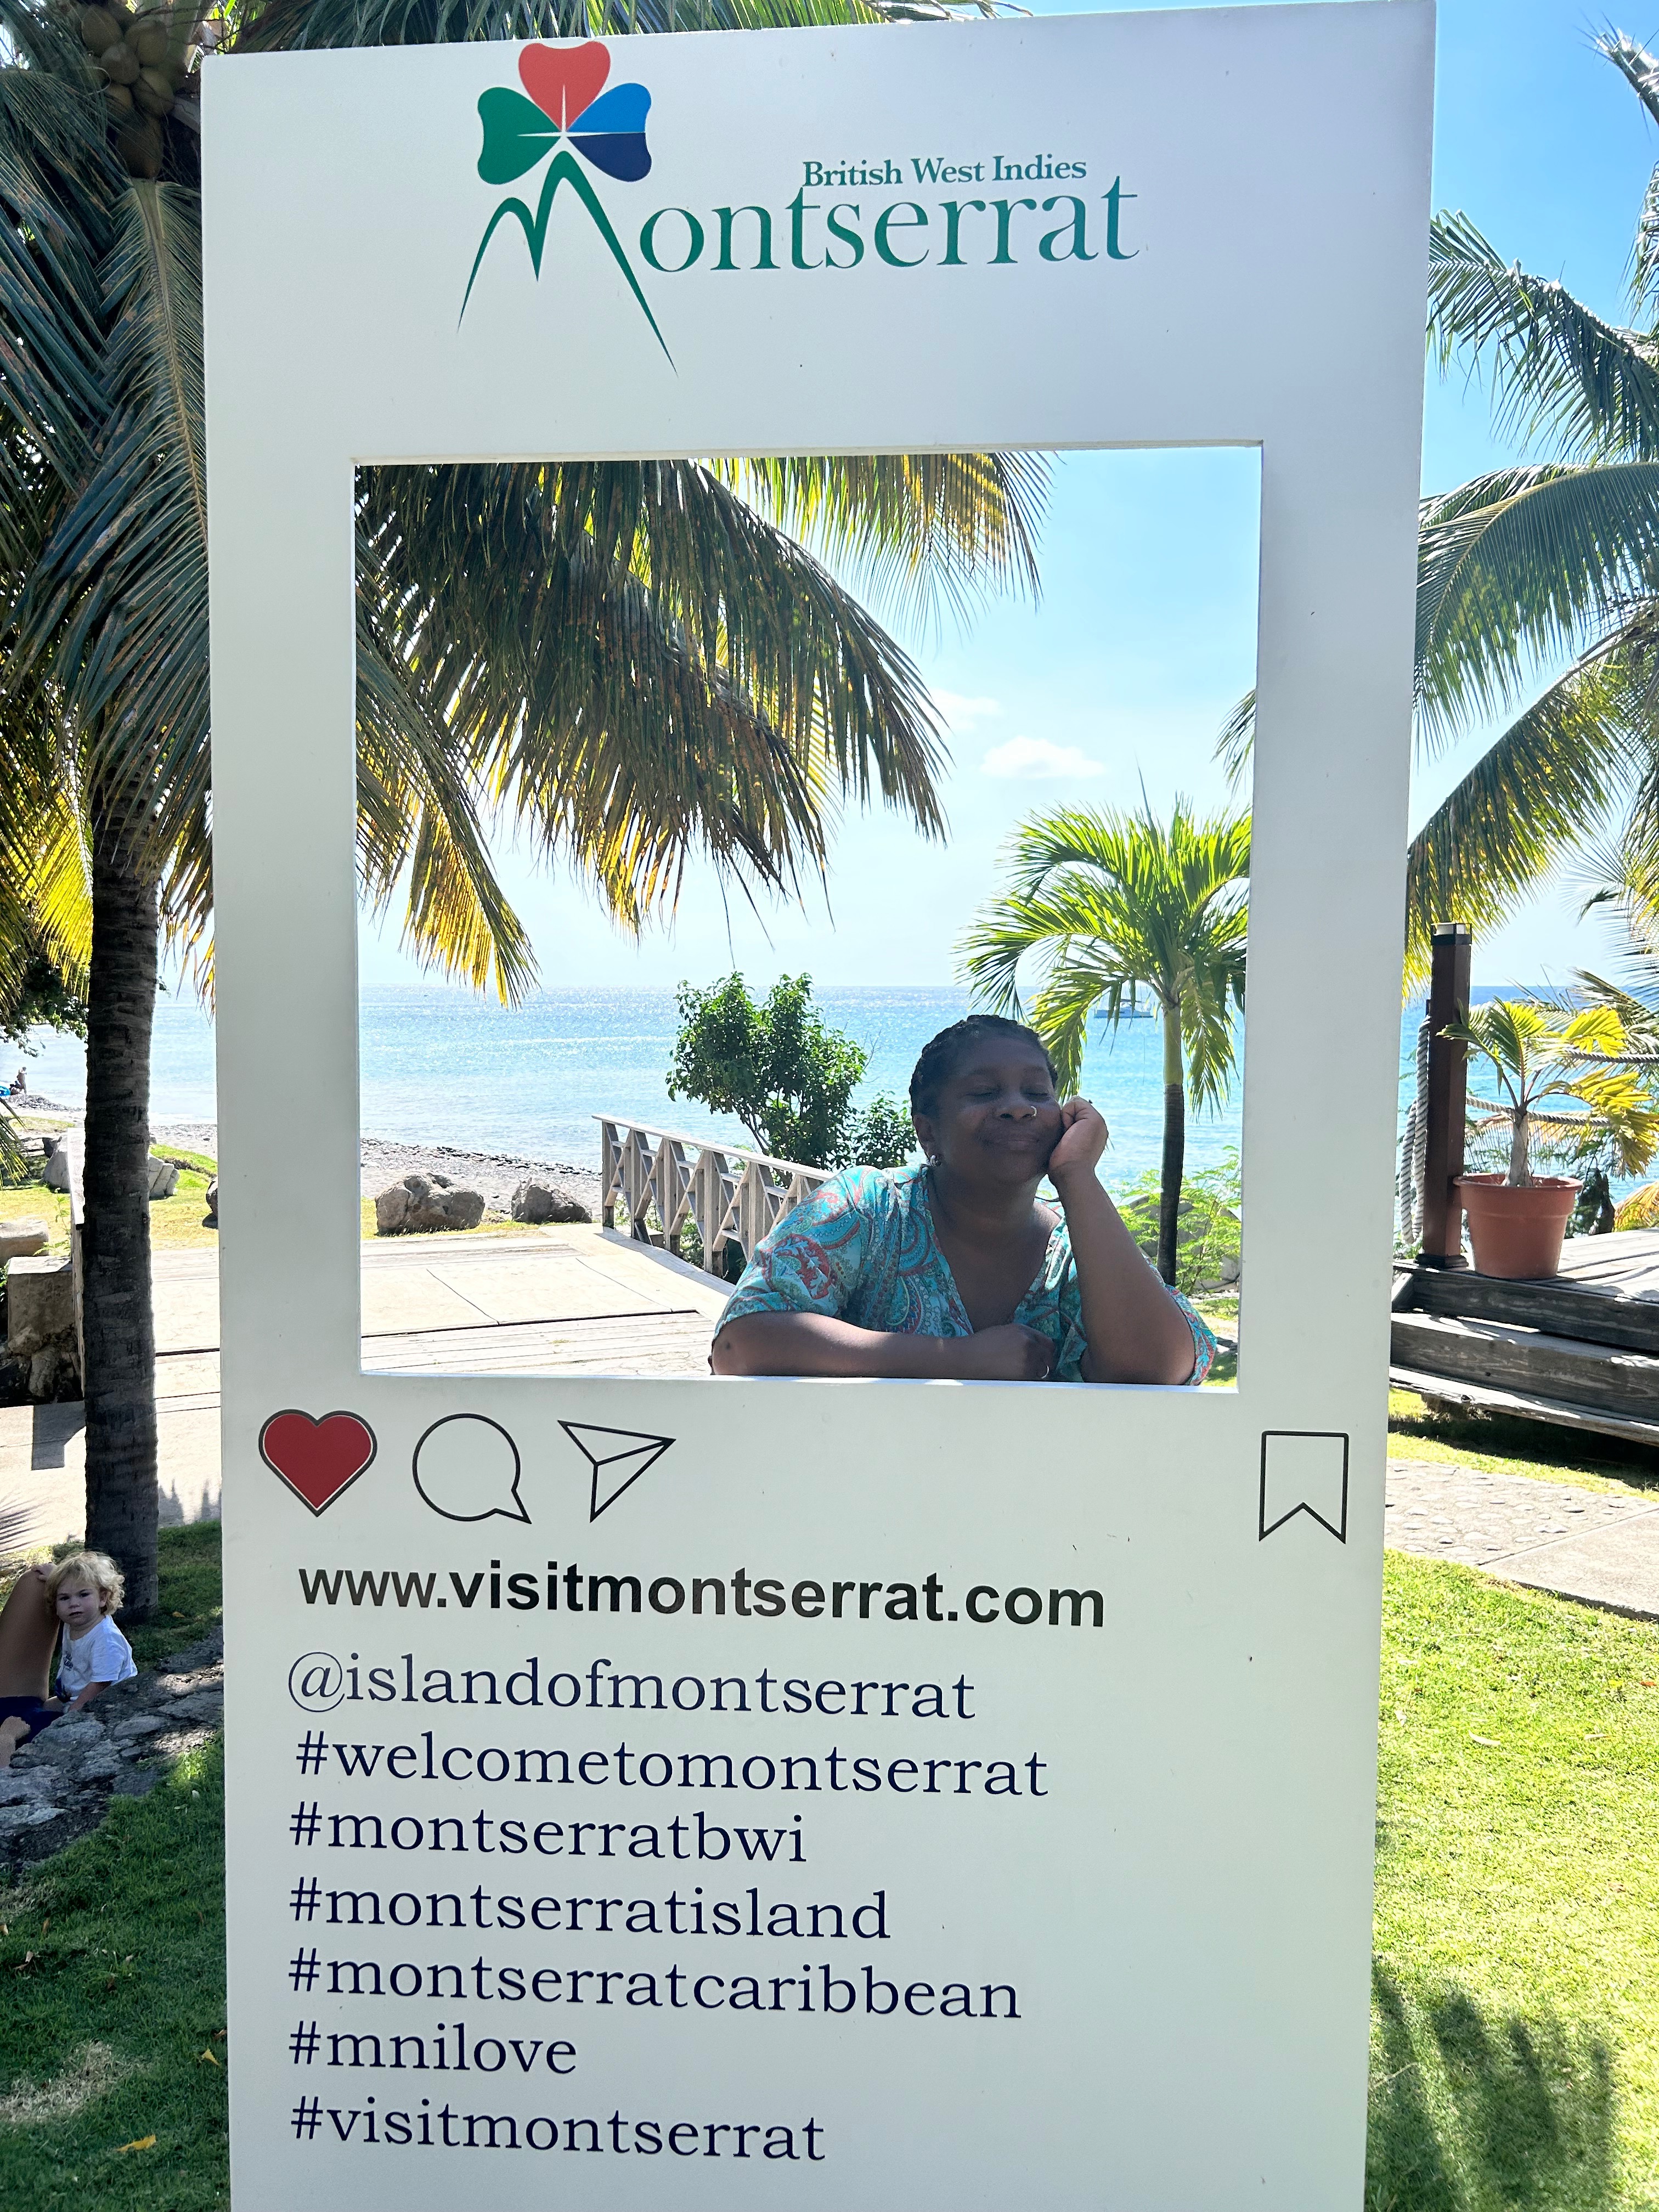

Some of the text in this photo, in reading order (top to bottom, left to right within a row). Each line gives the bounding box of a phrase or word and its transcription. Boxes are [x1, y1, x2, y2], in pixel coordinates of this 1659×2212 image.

[802, 154, 1087, 187] British West Indies
[458, 150, 1140, 374] Montserrat
[298, 1559, 1104, 1628] www.visitmontserrat.com
[288, 1651, 975, 1719] @islandofmontserrat
[296, 1730, 1048, 1796] #welcometomontserrat
[289, 1801, 807, 1862] #montserratbwi
[289, 1876, 891, 1939] #montserratisland
[288, 1947, 1022, 2019] #montserratcaribbean
[289, 2020, 577, 2075] #mnilove
[290, 2095, 826, 2161] #visitmontserrat
